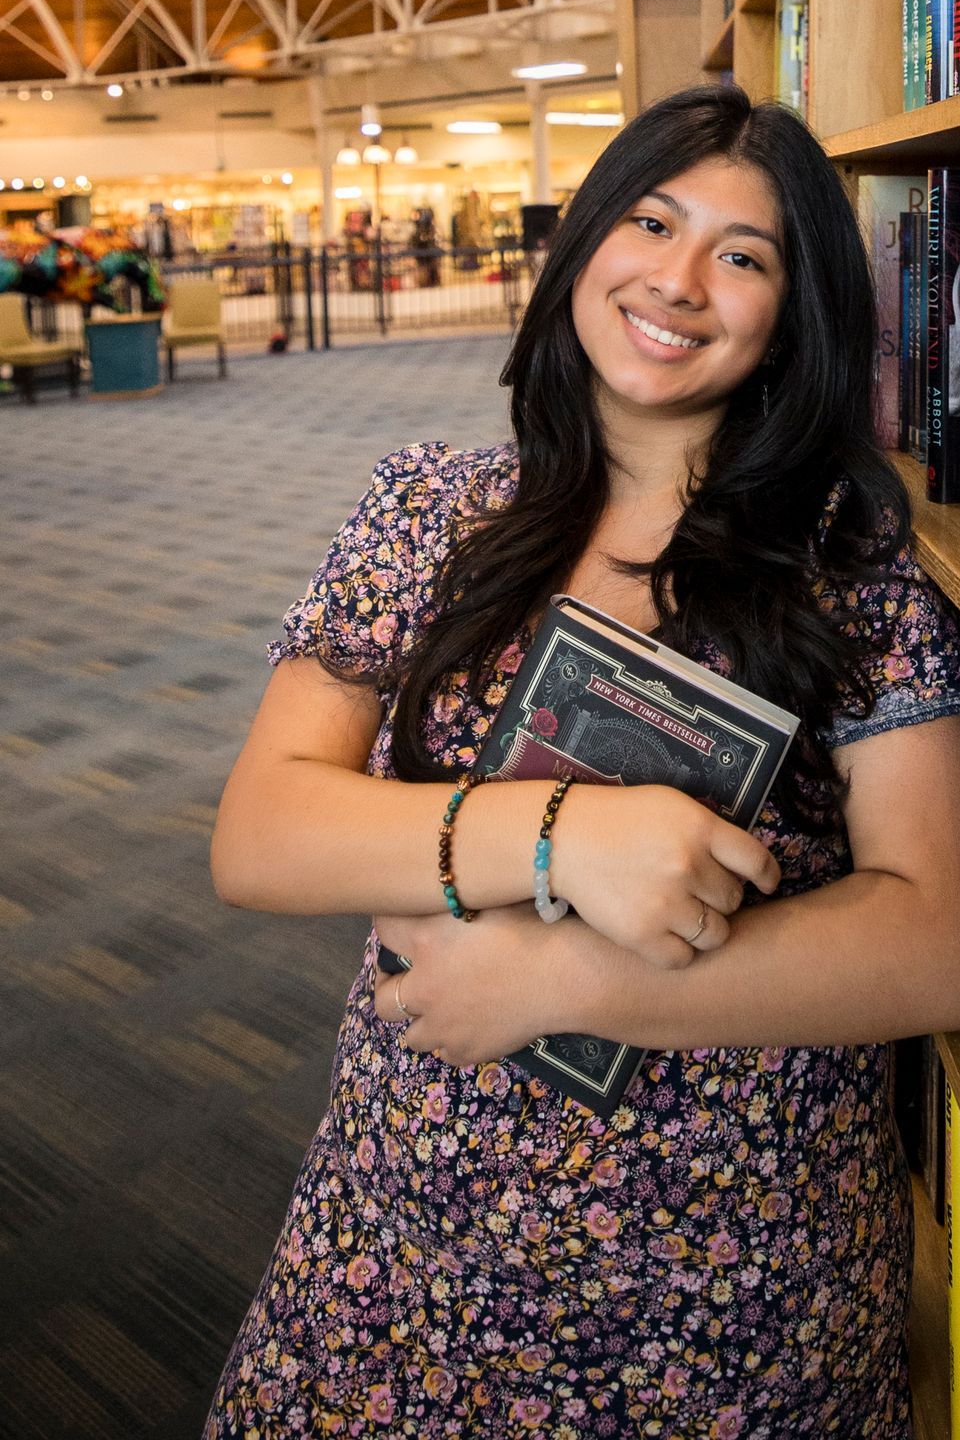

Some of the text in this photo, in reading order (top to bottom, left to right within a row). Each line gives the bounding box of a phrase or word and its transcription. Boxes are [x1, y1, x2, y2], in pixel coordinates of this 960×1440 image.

[928, 186, 939, 370] WHERE YOU END
[932, 387, 942, 446] ABBOTT
[593, 681, 708, 749] NEW YORK TIMES BESTSELLER
